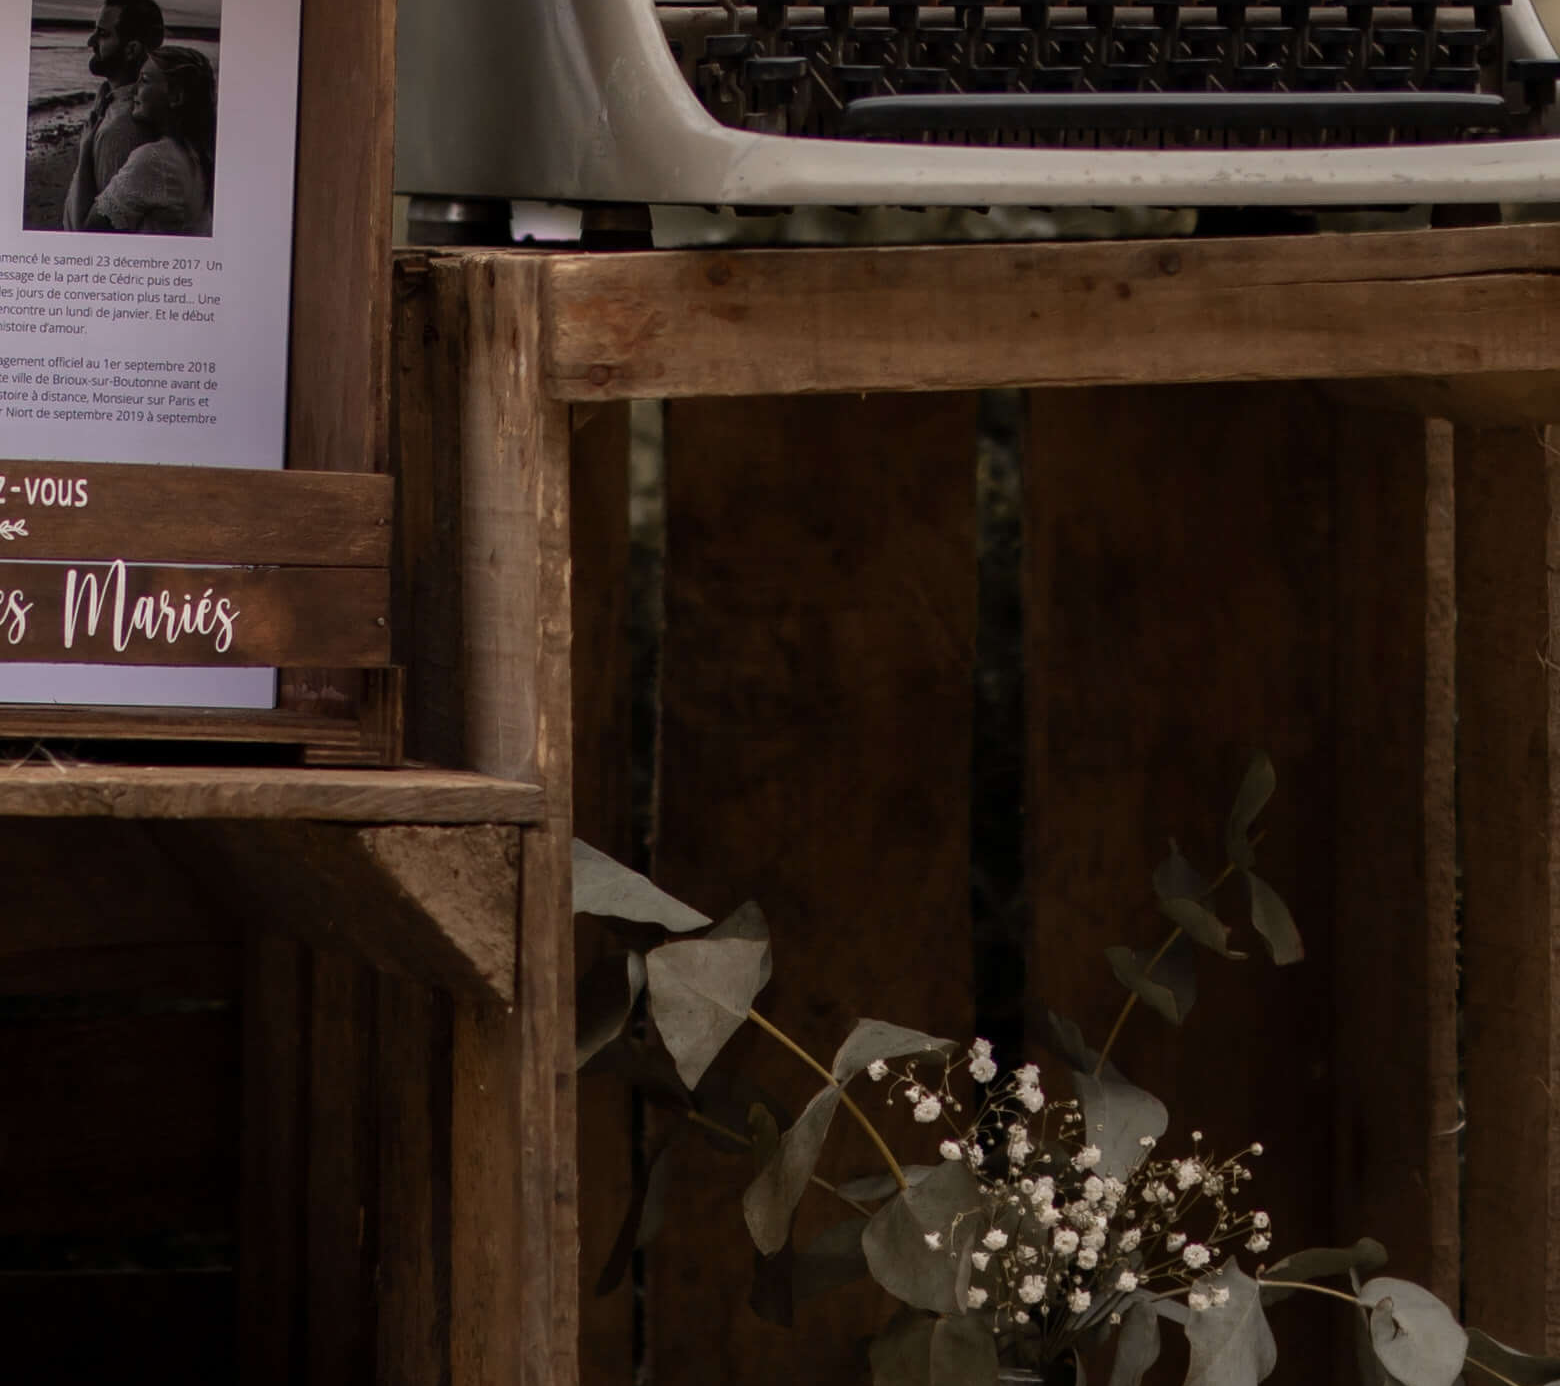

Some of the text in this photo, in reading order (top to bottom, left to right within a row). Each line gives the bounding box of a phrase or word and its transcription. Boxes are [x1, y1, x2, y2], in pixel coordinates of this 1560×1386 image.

[40, 252, 51, 265] le
[53, 255, 93, 266] samedi
[95, 255, 111, 267] 23
[112, 256, 170, 269] décembre
[171, 258, 202, 270] 2017.
[206, 260, 223, 271] Un
[36, 269, 51, 282] de
[54, 270, 64, 282] la
[66, 273, 89, 285] part
[91, 272, 107, 284] de
[108, 272, 144, 285] Cédric
[146, 275, 170, 288] puis
[172, 276, 193, 287] des
[15, 287, 44, 301] jours
[46, 287, 61, 300] de
[63, 290, 134, 302] conversation
[136, 291, 160, 304] plus
[163, 292, 195, 304] tard...
[197, 293, 221, 305] Une
[48, 307, 63, 316] un
[65, 305, 93, 318] lundi
[95, 306, 111, 318] de
[111, 308, 152, 321] janvier.
[155, 308, 166, 320] Et
[168, 308, 179, 321] le
[181, 309, 214, 322] début
[39, 322, 87, 334] d'amour.
[47, 356, 84, 369] officiel
[85, 359, 100, 369] au
[103, 358, 122, 370] 1er
[124, 360, 185, 373] septembre
[187, 361, 216, 373] 2018
[11, 372, 33, 384] ville
[34, 372, 50, 385] de
[52, 373, 168, 389] Brioux-sur-Boutonne
[170, 380, 201, 389] avant
[203, 378, 218, 390] de
[31, 389, 38, 402] à
[40, 390, 89, 404] distance,
[92, 392, 144, 405] Monsieur
[146, 396, 165, 405] sur
[168, 394, 196, 407] Paris
[197, 397, 209, 407] et
[5, 406, 33, 418] Niort
[35, 406, 51, 419] de
[52, 408, 113, 422] septembre
[115, 409, 145, 421] 2019
[146, 410, 154, 422] à
[156, 412, 217, 425] septembre
[64, 558, 240, 653] Mariés
